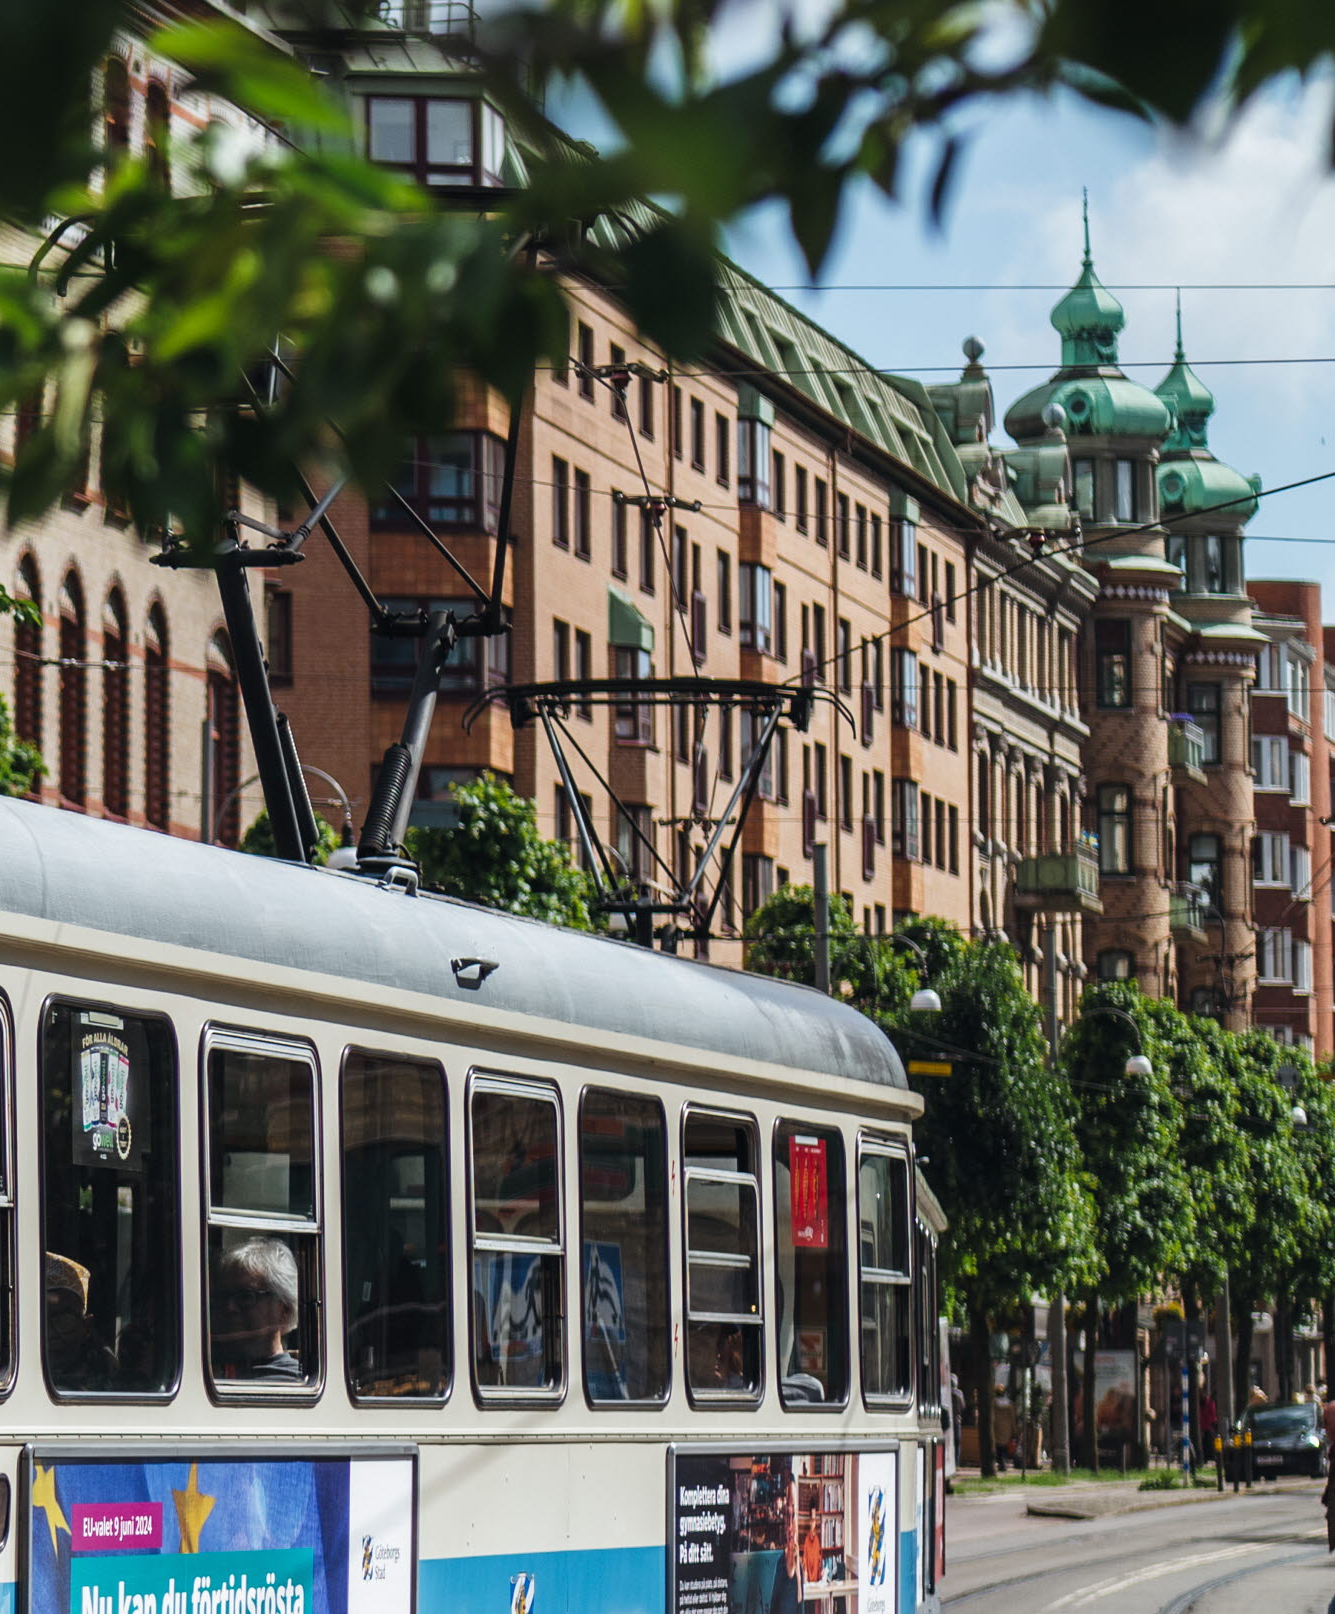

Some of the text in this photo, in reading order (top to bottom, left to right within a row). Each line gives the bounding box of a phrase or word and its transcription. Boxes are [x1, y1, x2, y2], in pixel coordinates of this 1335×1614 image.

[82, 1515, 153, 1542] EU-valet 9 juni 2024
